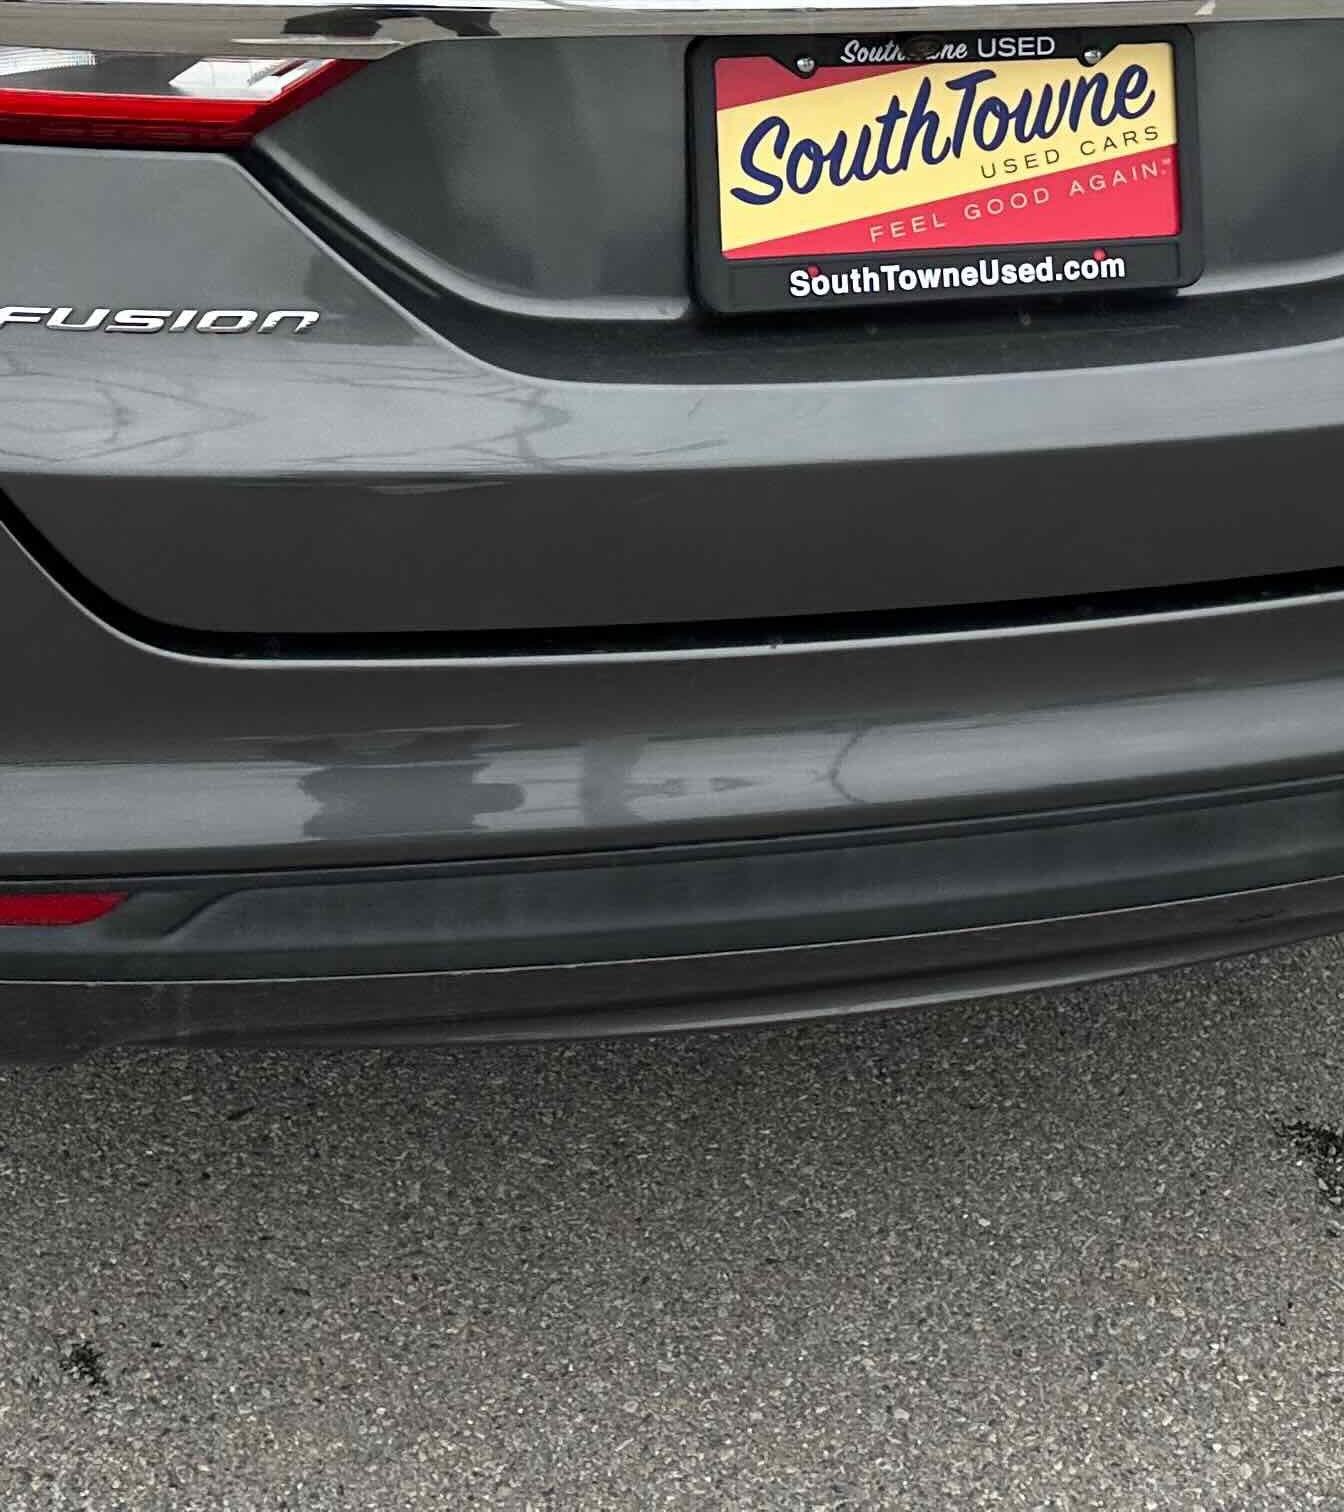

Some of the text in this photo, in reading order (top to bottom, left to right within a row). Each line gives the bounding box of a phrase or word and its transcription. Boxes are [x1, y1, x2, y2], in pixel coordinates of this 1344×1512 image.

[840, 36, 1056, 64] Southne USED
[730, 63, 1156, 206] SouthTowne
[980, 125, 1159, 179] USED CARS
[869, 212, 947, 243] FEEL
[963, 187, 1050, 220] GOOD
[789, 254, 1126, 297] SouthTowneUsed.com
